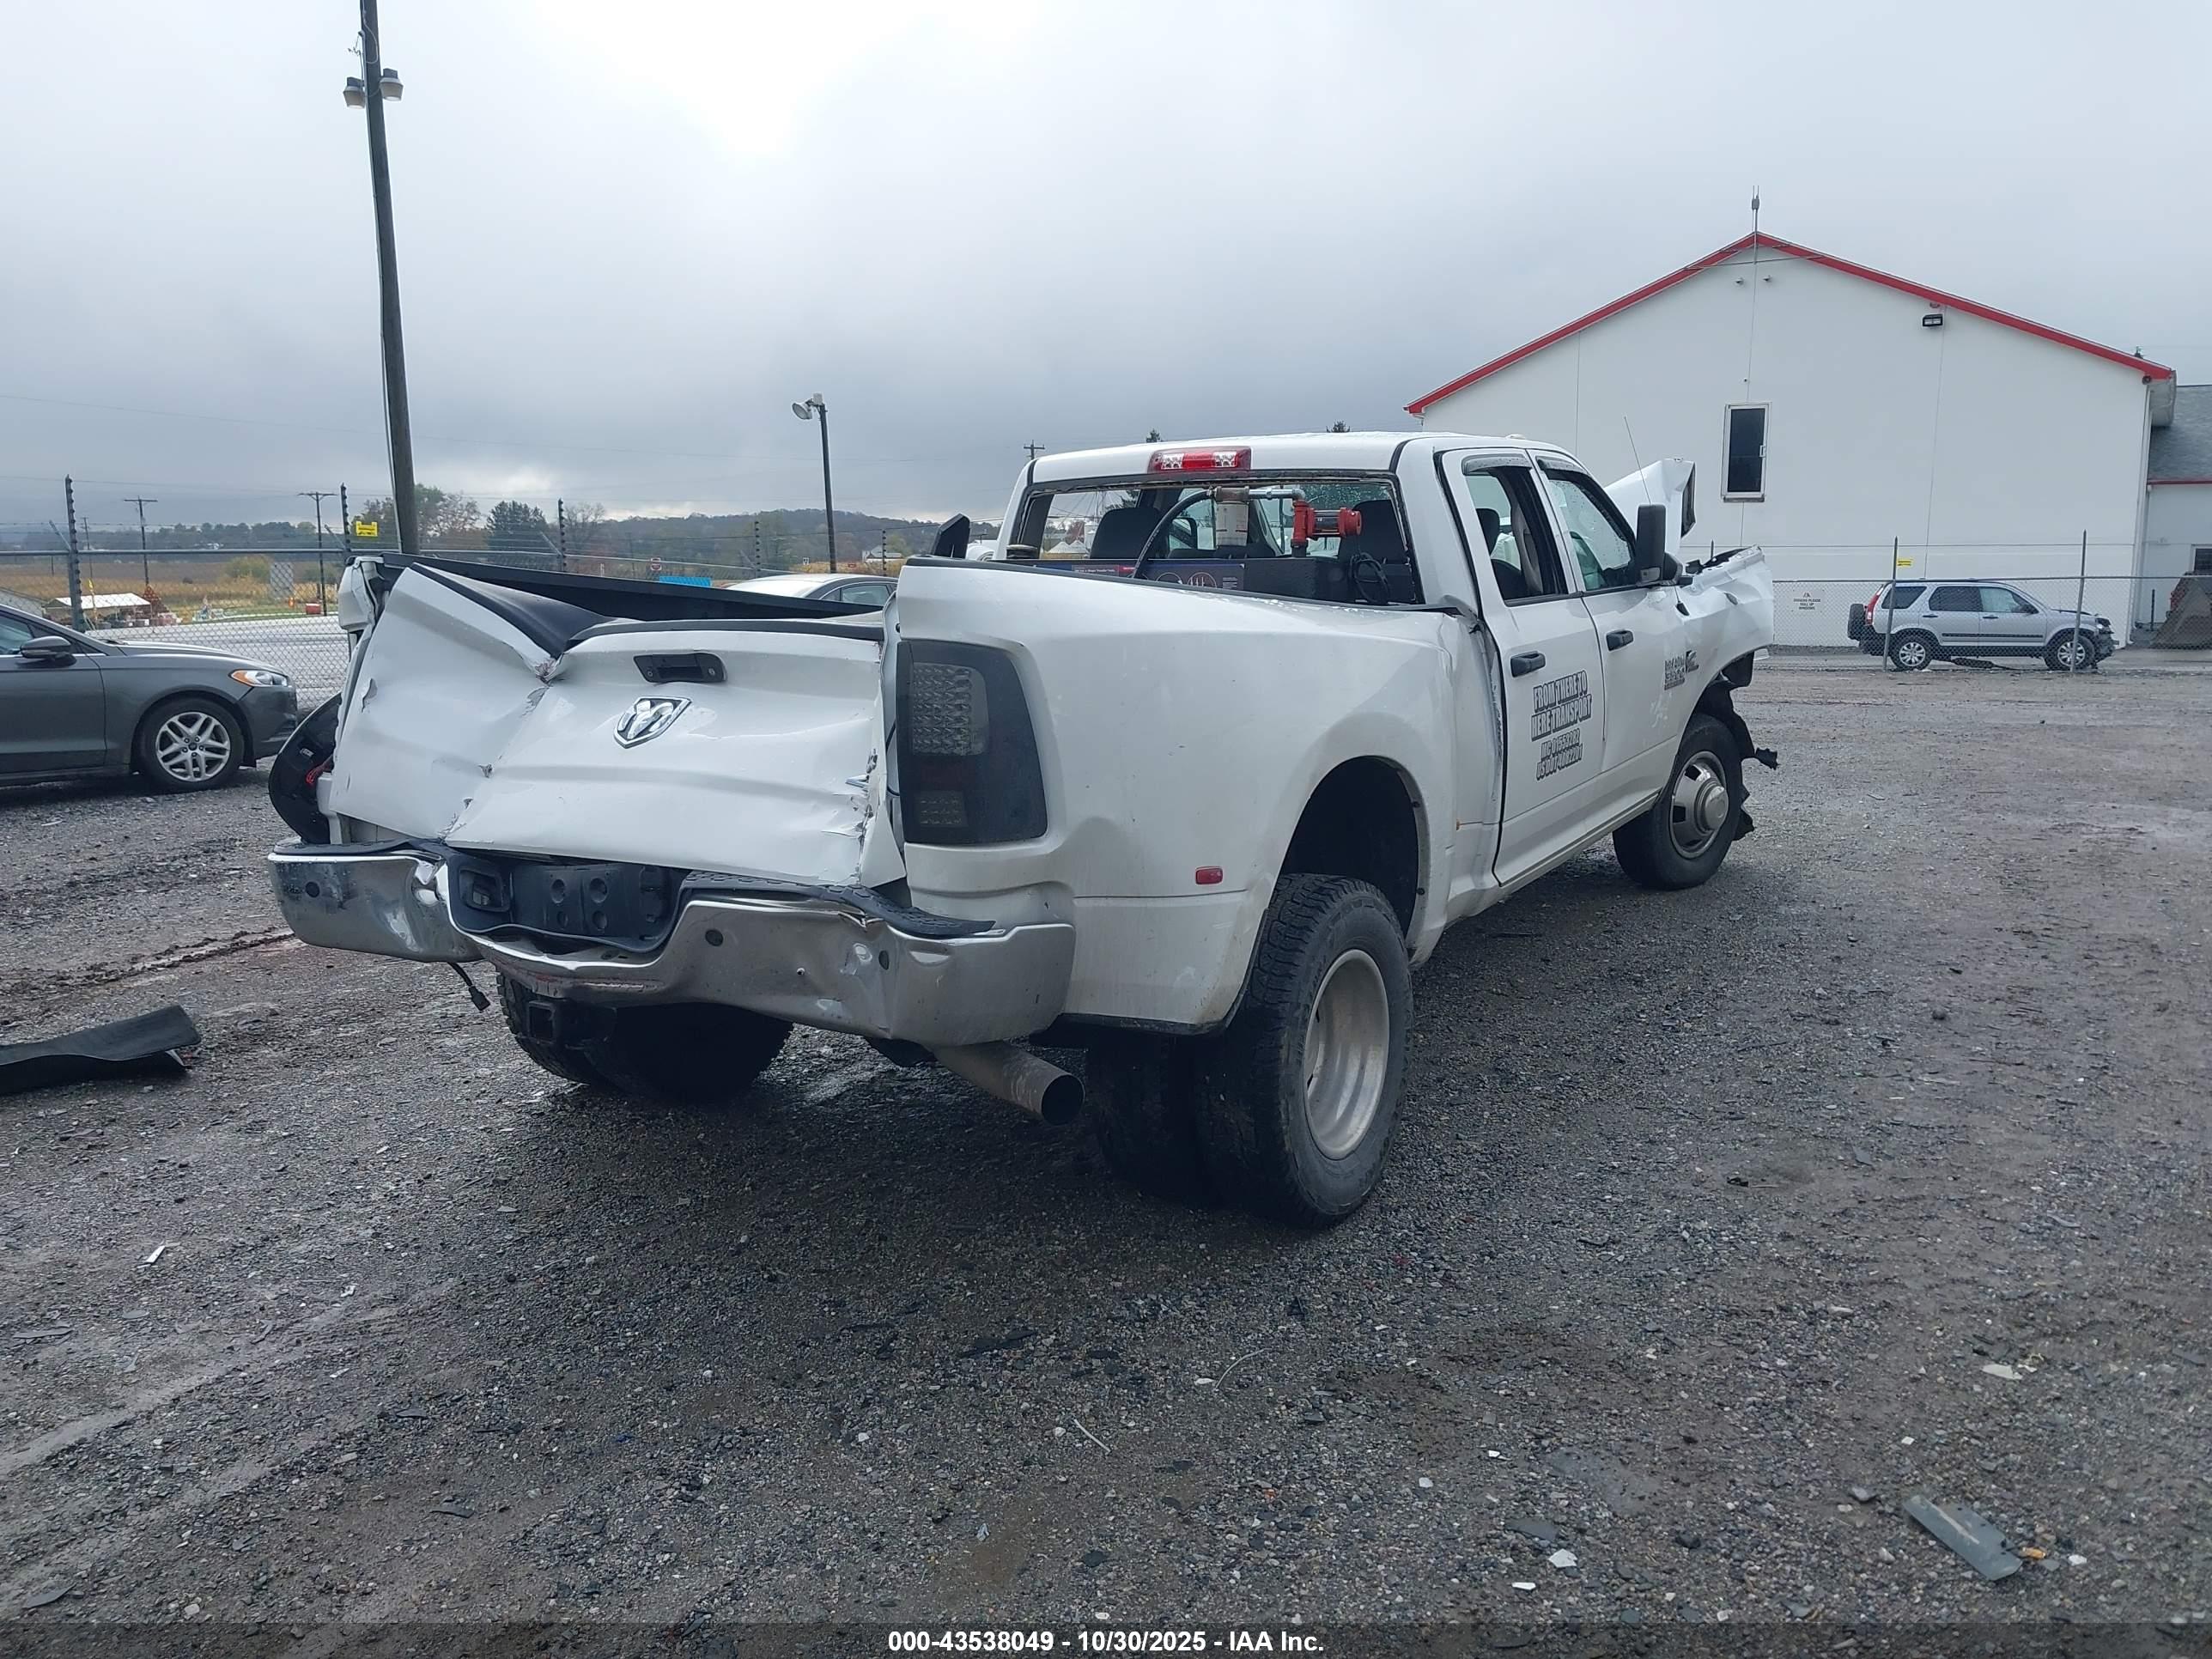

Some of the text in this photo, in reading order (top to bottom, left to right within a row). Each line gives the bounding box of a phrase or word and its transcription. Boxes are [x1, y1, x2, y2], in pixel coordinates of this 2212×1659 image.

[1533, 670, 1588, 713] FROM THERE TO
[1531, 694, 1592, 742] HERE TRANSPORT
[1541, 740, 1552, 762] MC
